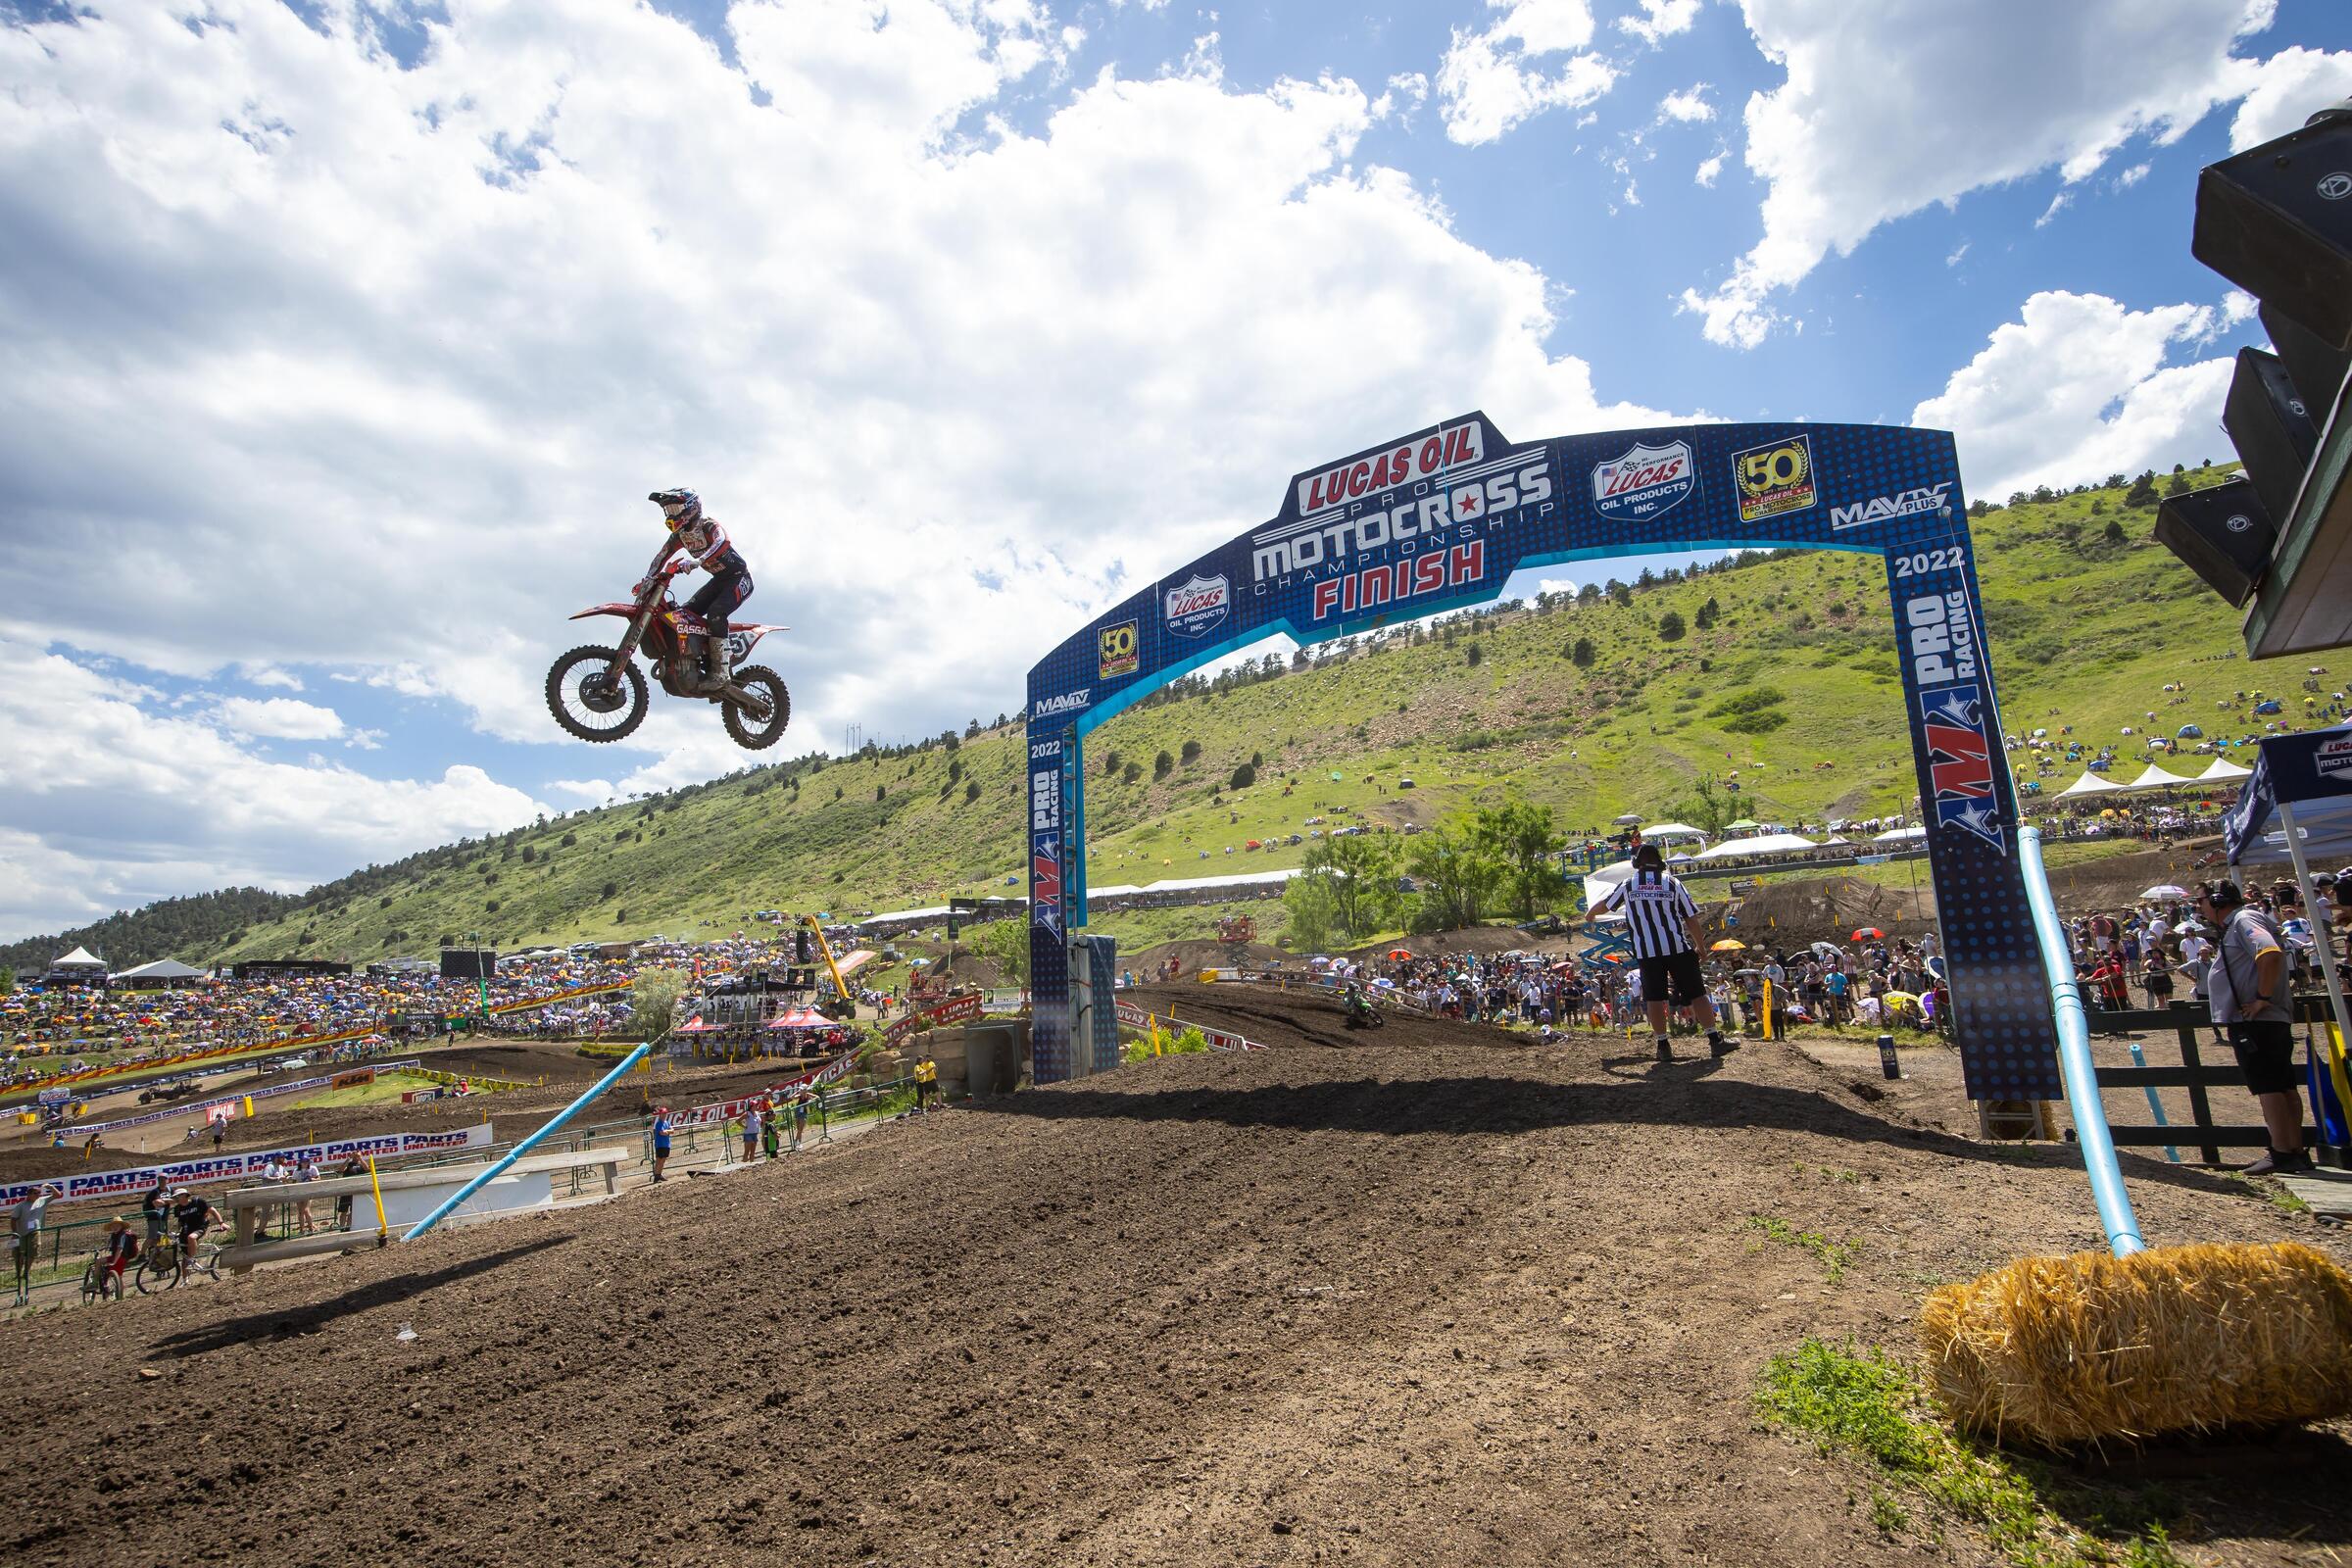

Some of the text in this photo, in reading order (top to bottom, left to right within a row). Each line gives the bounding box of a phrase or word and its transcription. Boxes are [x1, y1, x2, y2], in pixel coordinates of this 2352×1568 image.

[1306, 425, 1474, 512] LUCAS OIL
[1642, 452, 1685, 467] PERFORMANCE
[1746, 448, 1801, 492] 50
[1604, 460, 1683, 497] LUCAS
[1350, 482, 1428, 516] PRO
[1600, 481, 1688, 511] OIL PRODUCTS
[1634, 503, 1658, 514] INC.
[1744, 493, 1811, 514] PRO MOTOCROSS
[1755, 502, 1803, 516] CHAMPIONSHIP
[1760, 492, 1782, 503] LUCAS
[1830, 481, 1952, 527] MAVTV
[1906, 498, 1937, 513] PLUS
[1252, 463, 1551, 582] MOTOCROSS
[1254, 502, 1554, 597] CHAMPIONSHIP
[1894, 546, 1965, 577] 2022
[1313, 539, 1485, 620] FINISH
[1169, 608, 1225, 628] OIL PRODUCTS
[1172, 589, 1223, 616] LUCAS
[1105, 627, 1134, 659] 50
[1190, 623, 1206, 632] INC.
[1906, 595, 1955, 685] PRO
[1944, 591, 1976, 678] RACING
[1036, 688, 1090, 714] MAVTV
[1031, 740, 1060, 760] 2022
[1034, 771, 1051, 830] PRO
[1051, 769, 1059, 827] RACING
[1118, 1009, 1145, 1023] UCAS
[706, 1104, 728, 1121] OIL
[0, 1131, 468, 1199] ARS PARTS PARTS PARTS PARTS PARTS
[70, 1180, 157, 1198] UNLIMITED
[327, 1147, 399, 1161] UNMITED
[403, 1140, 467, 1152] UNLIMITED
